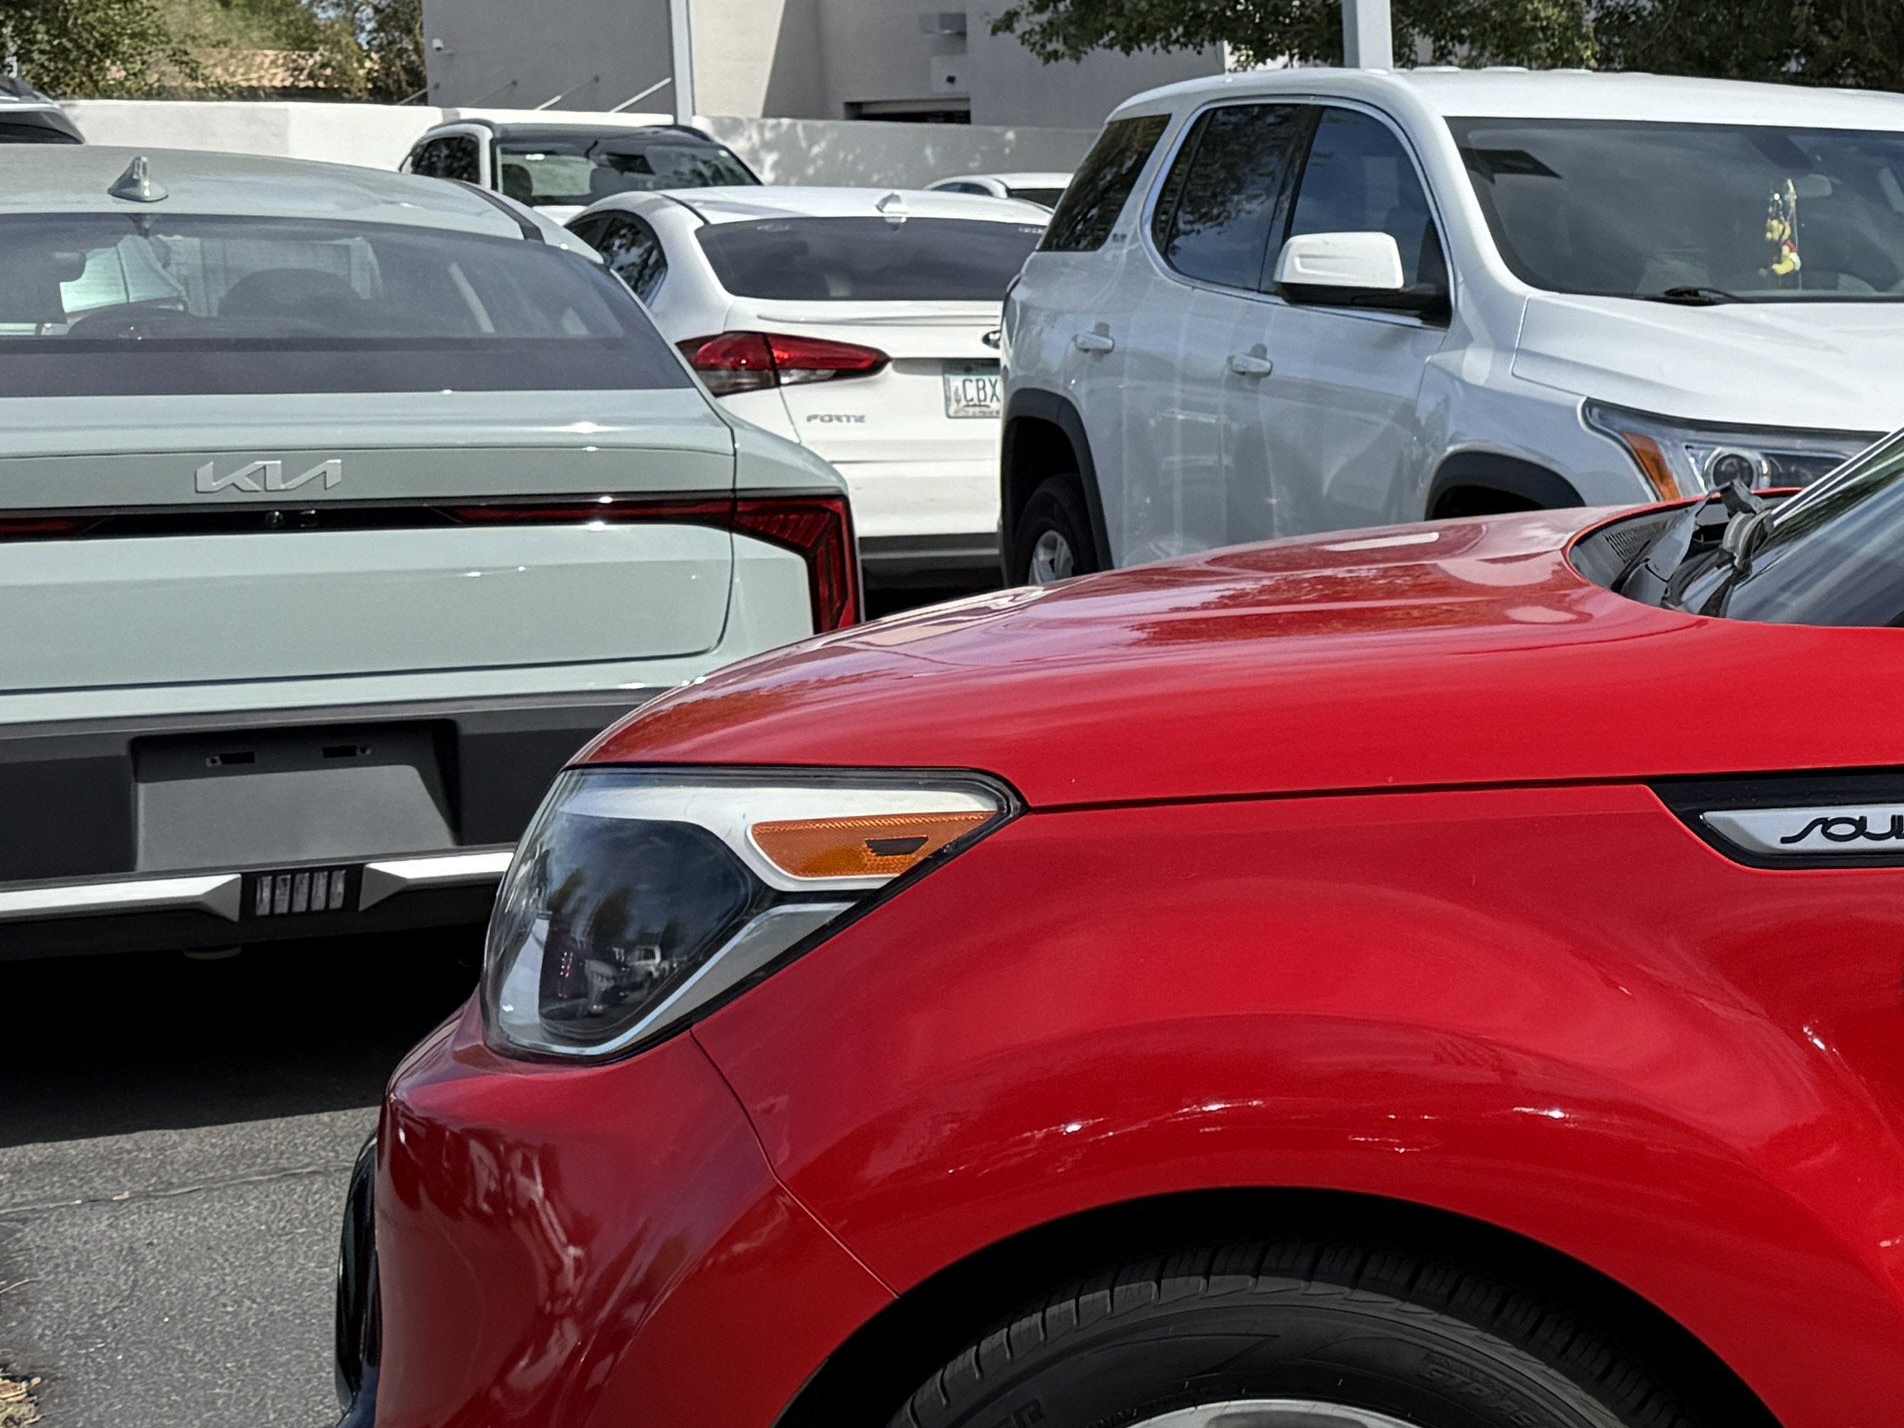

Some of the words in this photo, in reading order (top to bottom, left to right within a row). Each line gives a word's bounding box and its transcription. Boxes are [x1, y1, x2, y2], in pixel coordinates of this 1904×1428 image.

[962, 377, 1001, 403] CBX
[806, 413, 866, 424] FORTE
[195, 459, 342, 493] KIA
